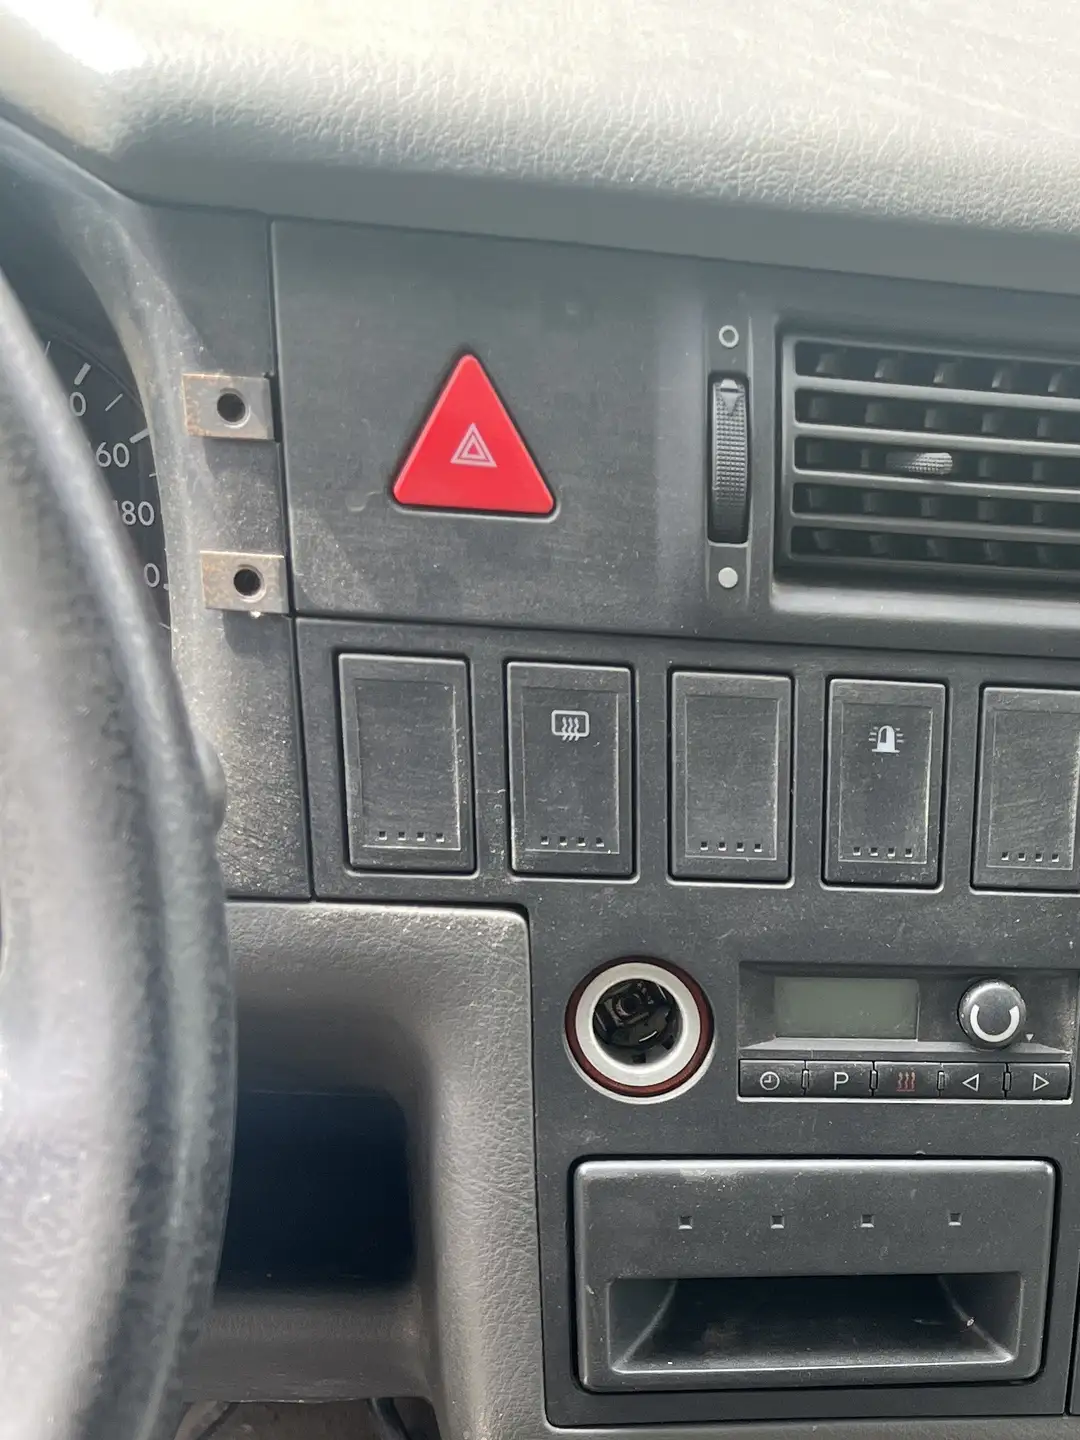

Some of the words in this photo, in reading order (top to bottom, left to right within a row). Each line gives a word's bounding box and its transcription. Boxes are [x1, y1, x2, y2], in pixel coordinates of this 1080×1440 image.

[69, 391, 87, 417] 0
[96, 442, 130, 468] 60
[121, 500, 155, 527] 80
[833, 1071, 849, 1091] P
